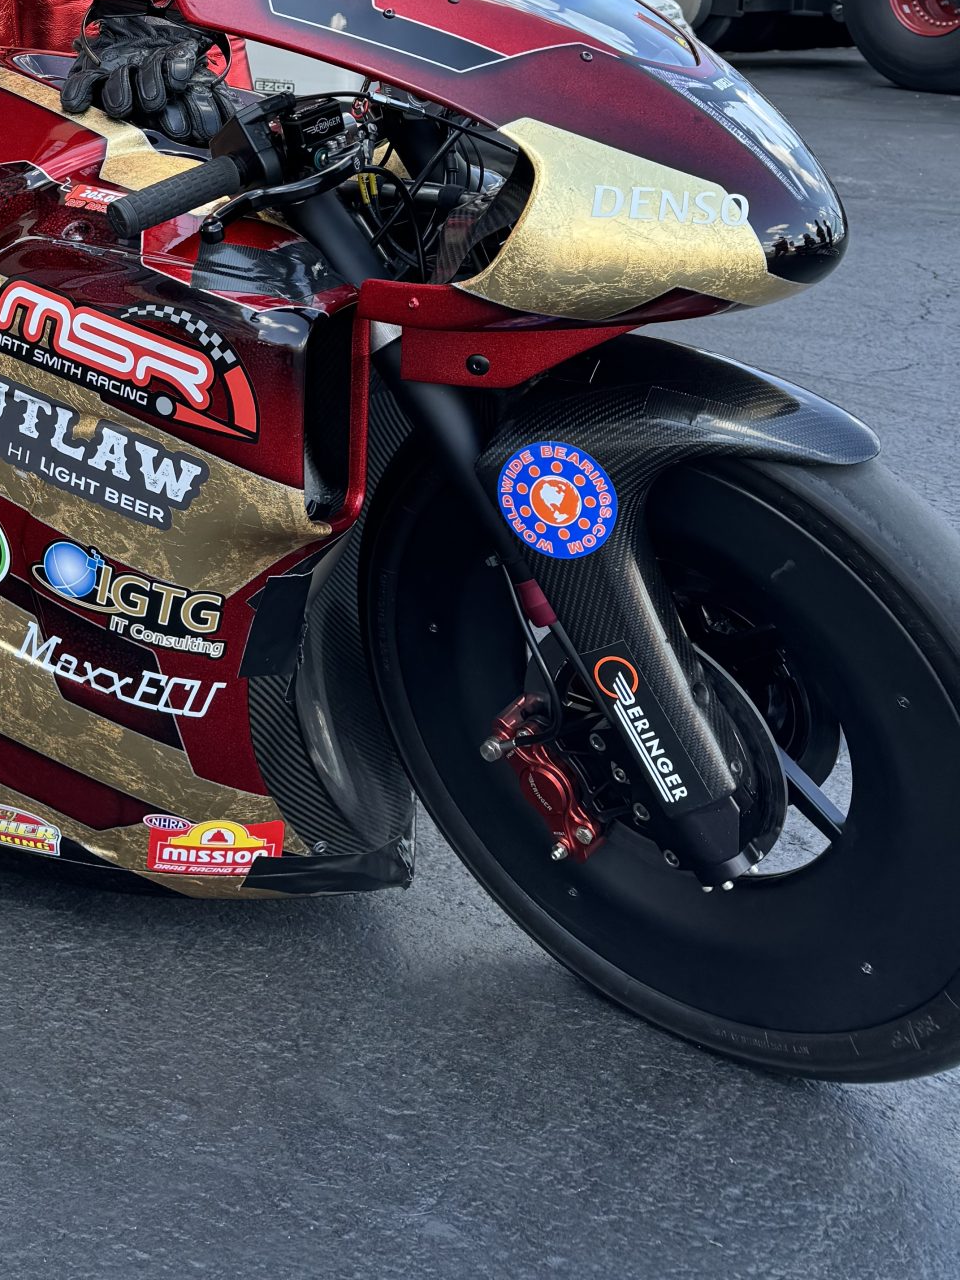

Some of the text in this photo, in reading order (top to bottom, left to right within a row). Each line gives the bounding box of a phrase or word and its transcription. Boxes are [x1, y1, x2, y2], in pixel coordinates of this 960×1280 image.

[303, 117, 341, 135] BERINGER
[591, 184, 749, 227] DENSO
[32, 349, 82, 379] SMITH
[86, 370, 149, 406] RACING
[7, 441, 30, 464] HI
[40, 456, 100, 495] LIGHT
[104, 489, 165, 523] BEER
[501, 445, 613, 555] WORLDWIDE BEARINGS.COM
[96, 564, 223, 634] IGTG
[109, 616, 225, 658] IT Consulting
[15, 621, 227, 718] MaxxECU
[613, 671, 688, 802] BERINGER
[151, 817, 184, 830] NHRA
[153, 863, 186, 872] DRAG
[188, 865, 233, 873] RACING
